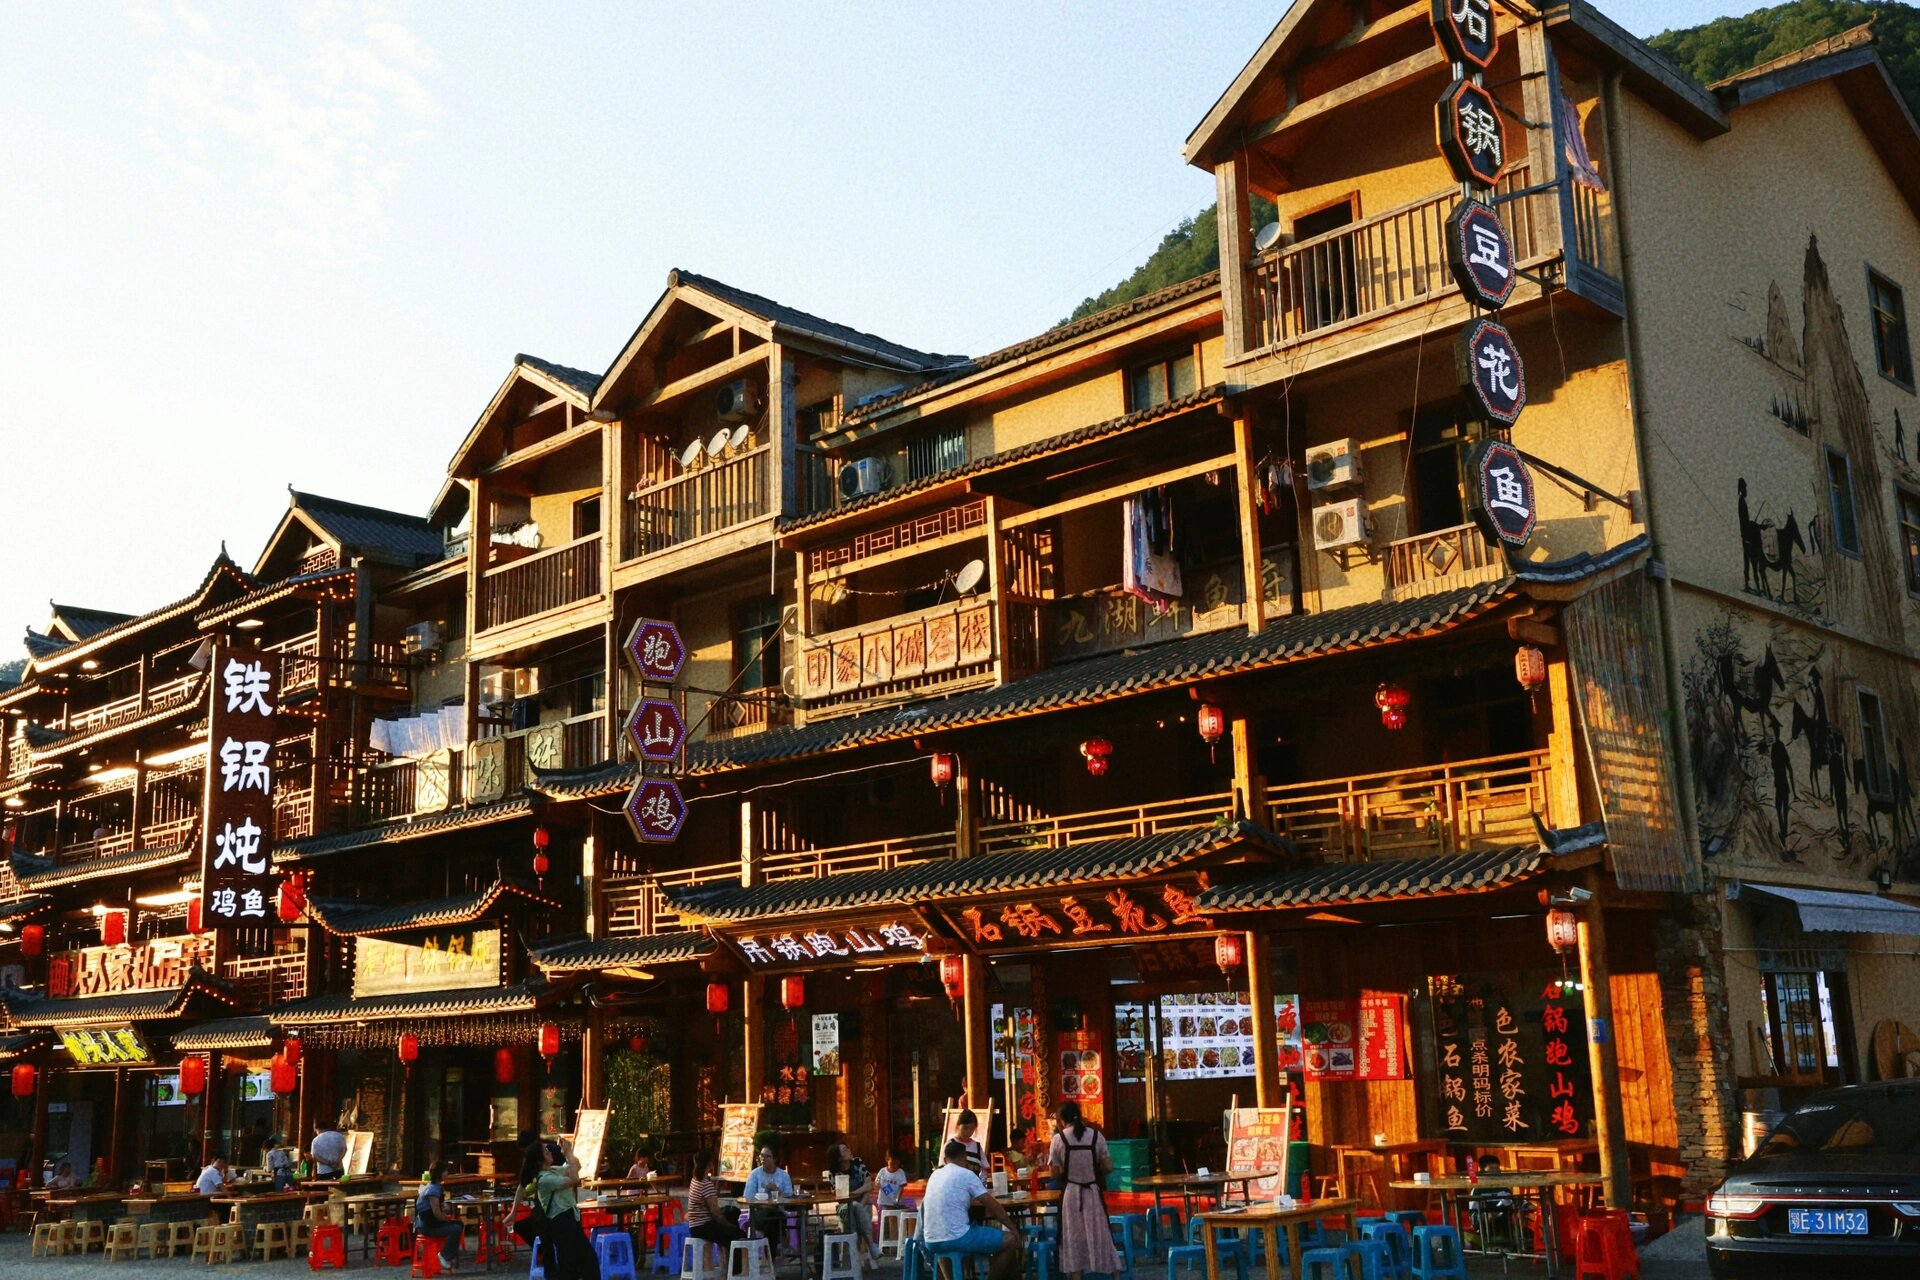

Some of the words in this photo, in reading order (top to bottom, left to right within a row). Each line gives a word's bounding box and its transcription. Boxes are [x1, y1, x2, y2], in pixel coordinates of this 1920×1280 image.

[1454, 0, 1530, 519] 石锅豆花鱼
[807, 612, 990, 689] 印象小城客栈
[212, 657, 273, 875] 铁锅炖
[641, 632, 677, 831] 跑山鸡
[211, 888, 266, 919] 鸡鱼
[737, 921, 924, 964] 吊锅跑山鸡
[962, 883, 1209, 943] 石锅豆花鱼
[1541, 984, 1579, 1134] 石锅跑山鸡
